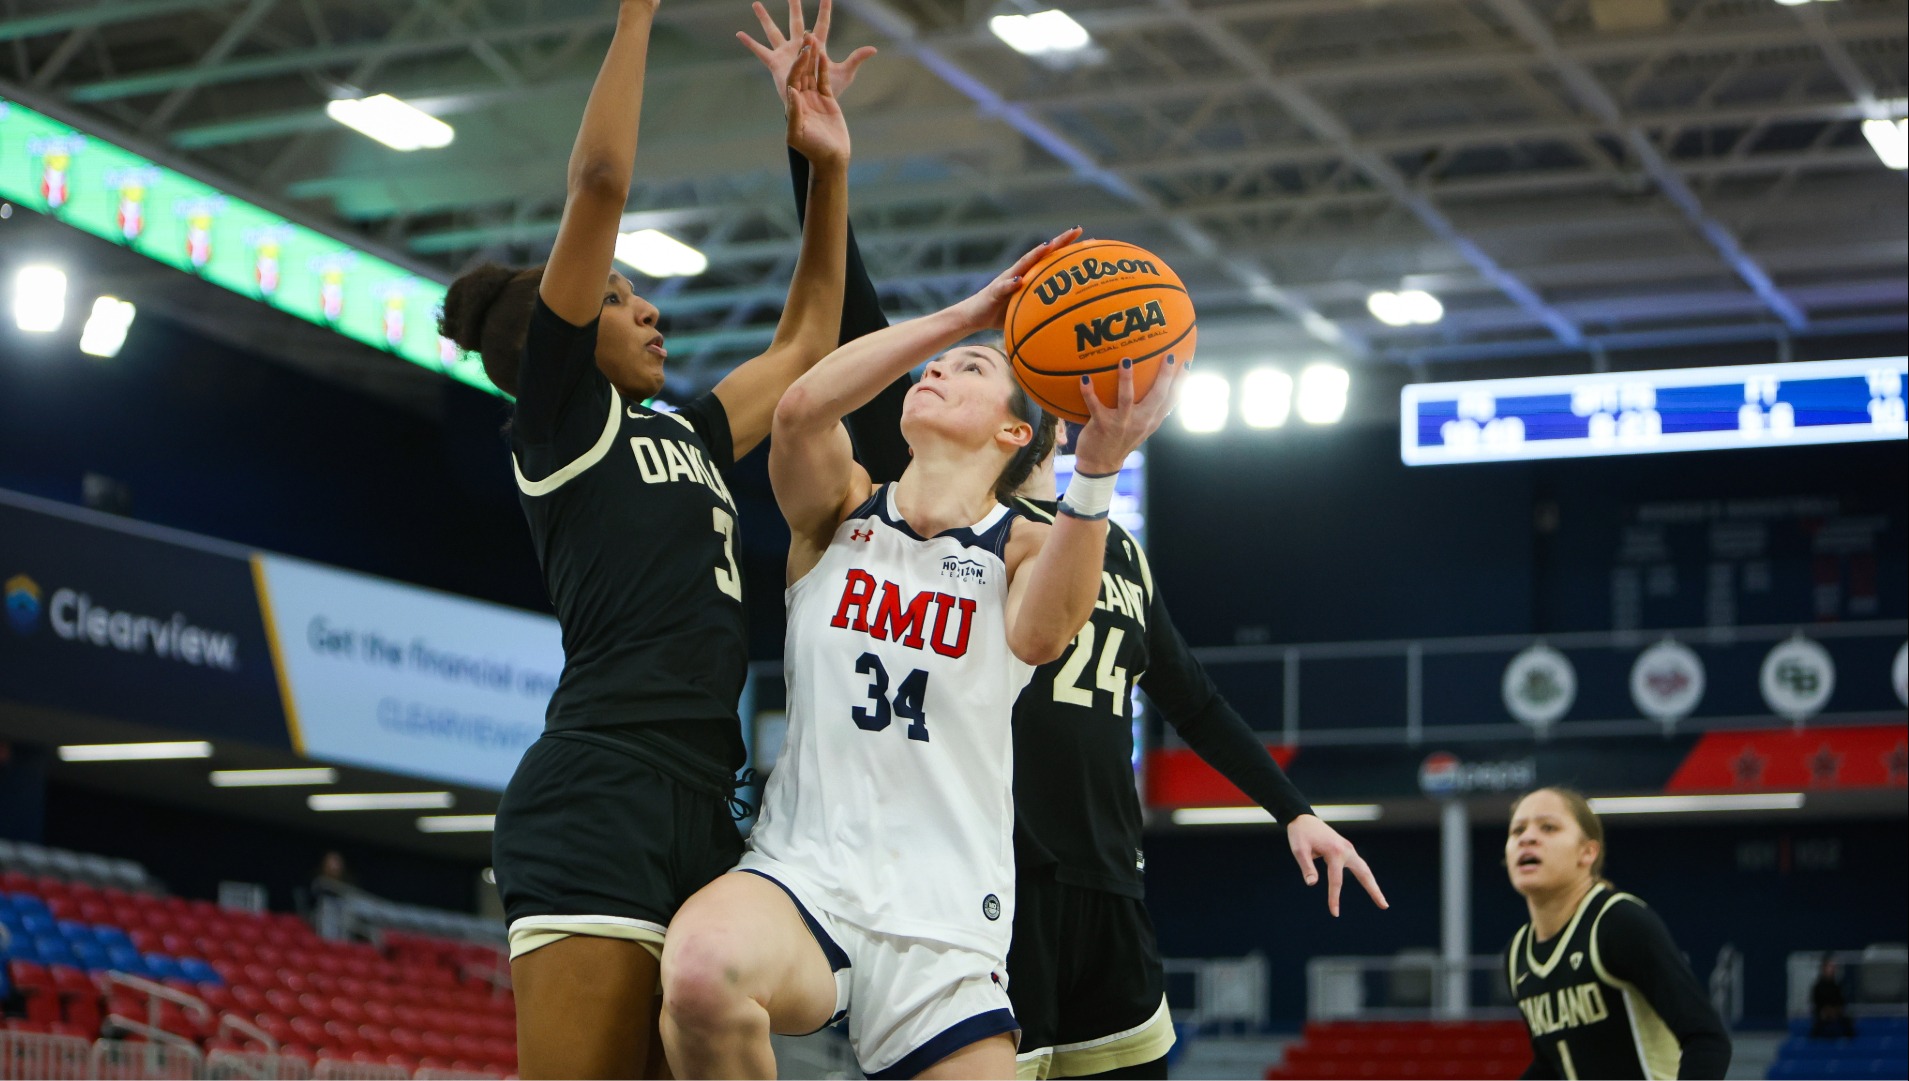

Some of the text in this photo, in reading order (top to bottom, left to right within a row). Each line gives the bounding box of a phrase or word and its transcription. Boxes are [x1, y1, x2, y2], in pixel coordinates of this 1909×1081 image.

[1034, 258, 1160, 305] Wilson
[1074, 300, 1167, 352] NCAA
[1078, 330, 1168, 360] OFFICIAL GAME BALL
[630, 437, 739, 516] OAKLA
[712, 506, 742, 602] 3
[942, 561, 984, 578] HOIZON
[50, 587, 236, 671] Clearview
[830, 568, 977, 660] RMU
[851, 651, 930, 743] 34
[1052, 620, 1126, 718] 24
